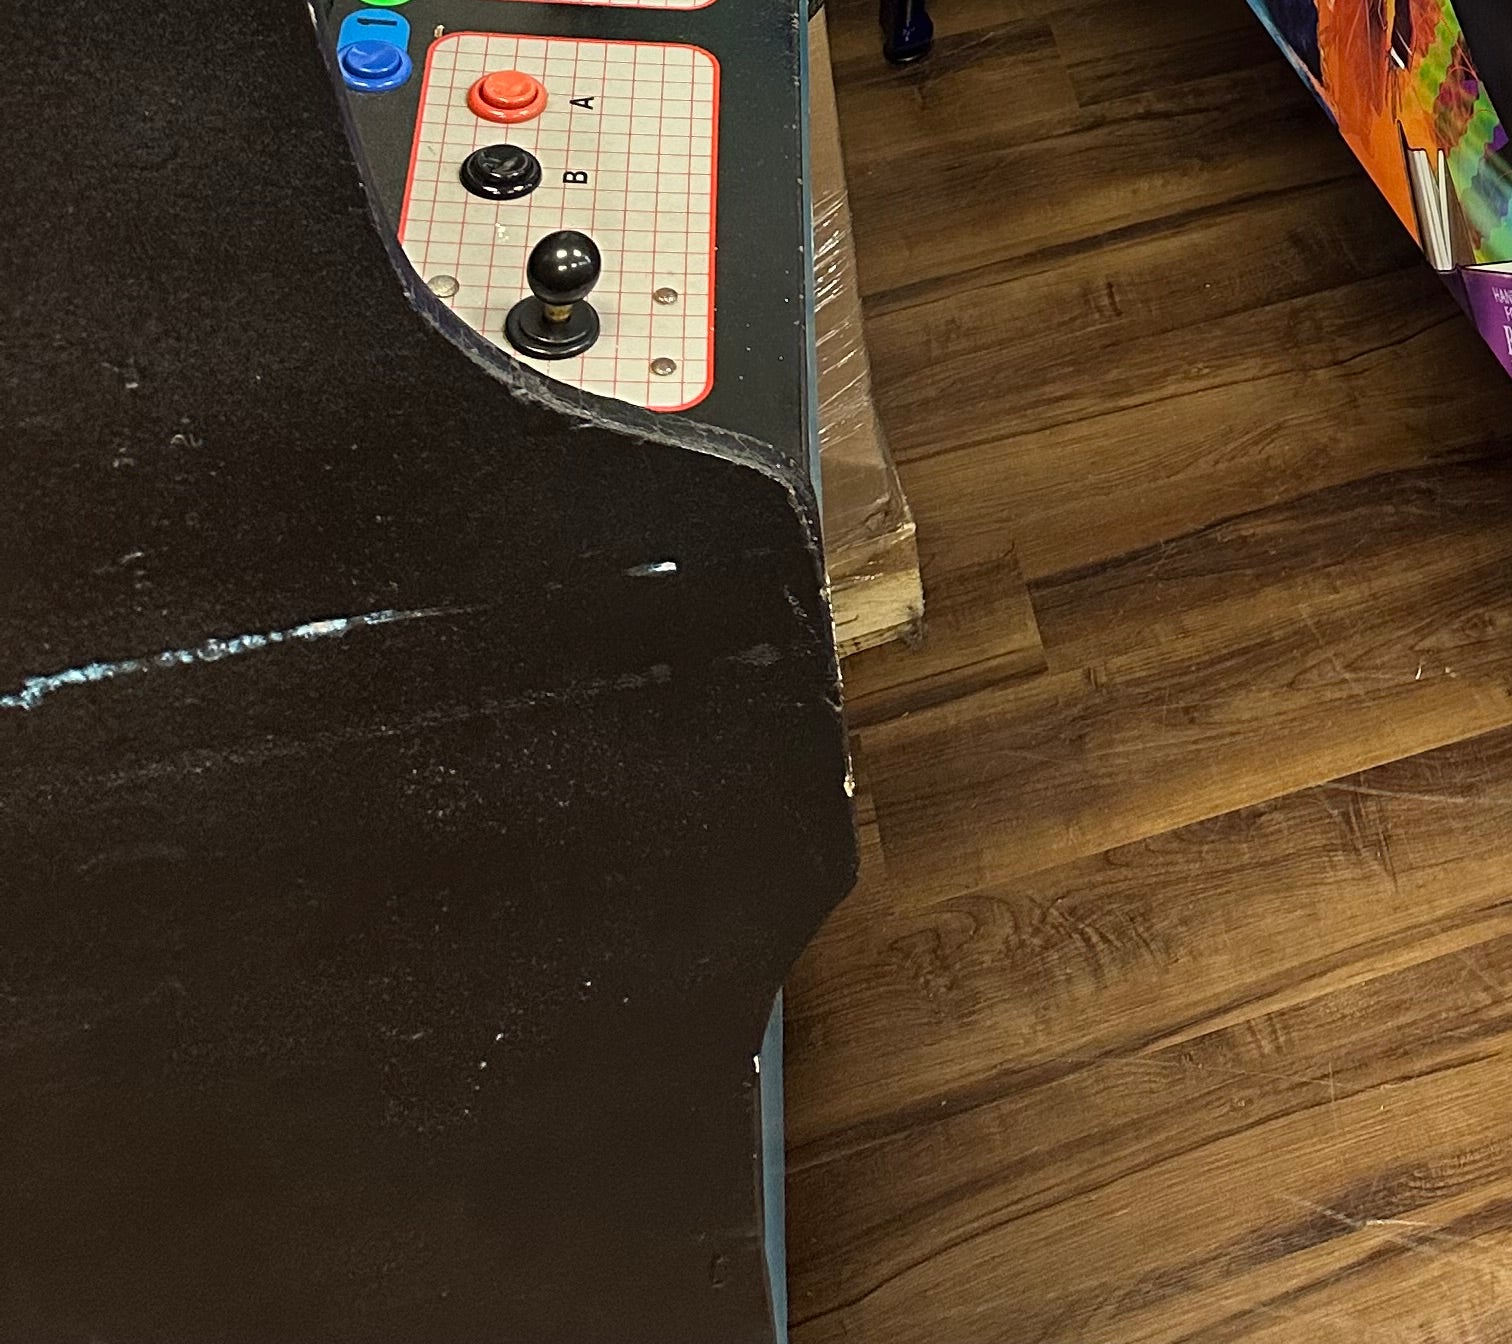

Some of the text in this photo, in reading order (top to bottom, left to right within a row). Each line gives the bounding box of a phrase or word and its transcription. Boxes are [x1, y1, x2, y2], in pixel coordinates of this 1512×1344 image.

[356, 16, 399, 28] 1
[570, 94, 595, 111] A
[562, 169, 588, 185] B
